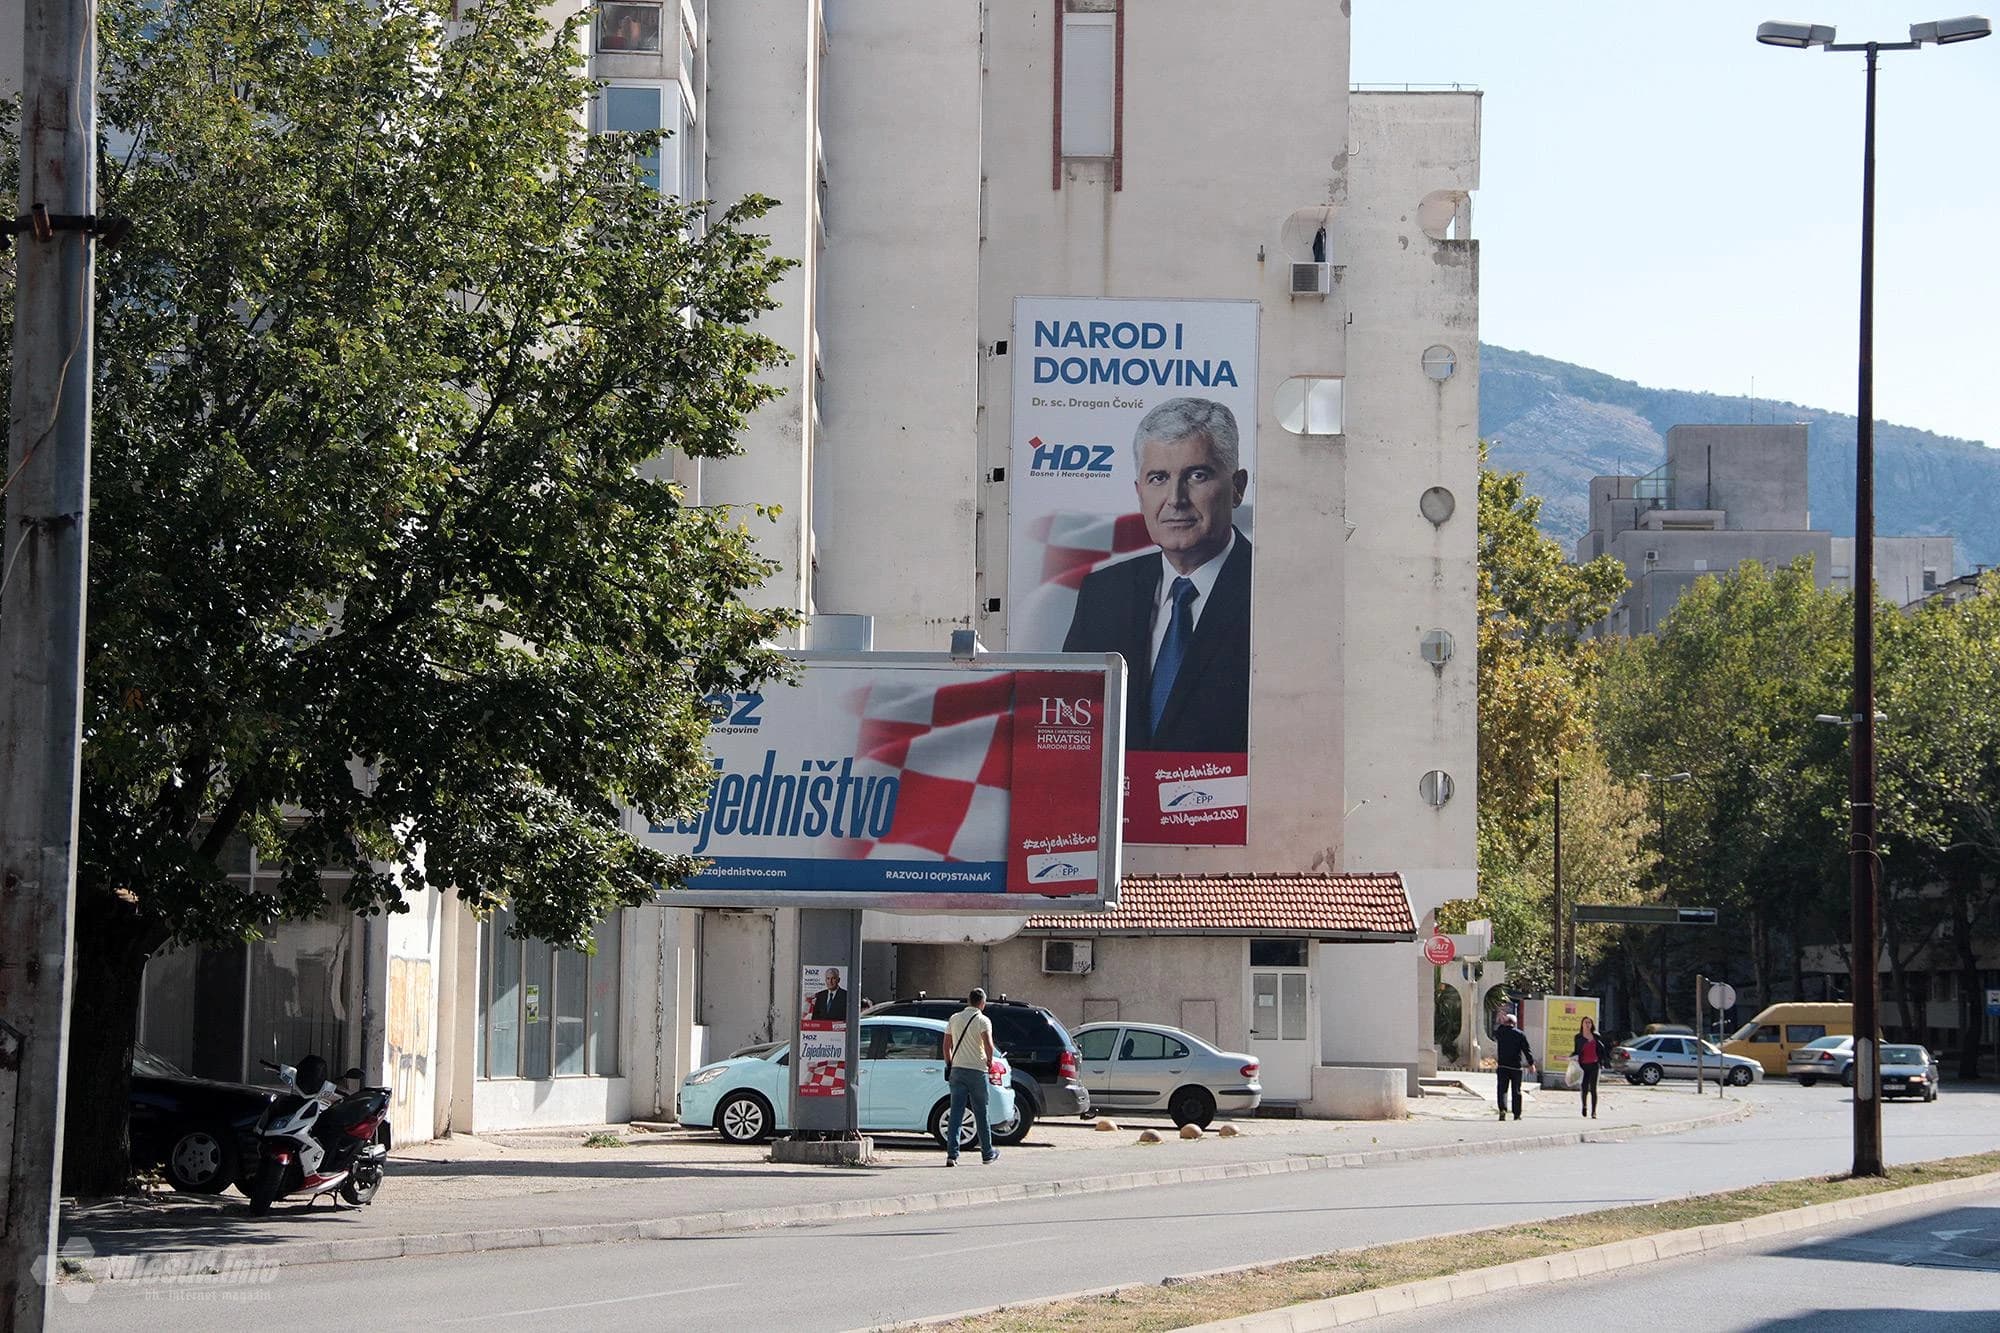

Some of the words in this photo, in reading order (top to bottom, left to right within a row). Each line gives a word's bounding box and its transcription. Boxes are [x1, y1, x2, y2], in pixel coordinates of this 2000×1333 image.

[1034, 320, 1167, 350] NAROD
[1175, 323, 1183, 350] I
[1033, 356, 1238, 388] DOMOVINA
[1032, 397, 1047, 407] Dr.
[1050, 399, 1066, 407] sc.
[1068, 398, 1110, 410] Dragan
[1112, 396, 1144, 409] Čović
[1031, 444, 1115, 472] HDZ
[1061, 471, 1111, 479] Hercegovine
[703, 692, 765, 725] DZ
[1039, 697, 1092, 726] HNS
[711, 726, 759, 735] rcegovine
[1037, 734, 1091, 744] HRVATSKI
[1155, 763, 1232, 782] #zajedništvo
[648, 750, 900, 853] jedništvo
[1196, 795, 1213, 804] EPP
[1023, 833, 1097, 853] #zajedništvo
[700, 866, 787, 877] .zajednistvo.com
[885, 870, 924, 880] RAZVOJ
[929, 871, 992, 882] O(P)STANAK
[1062, 867, 1079, 876] EPP
[802, 1042, 842, 1060] Zajedništvo
